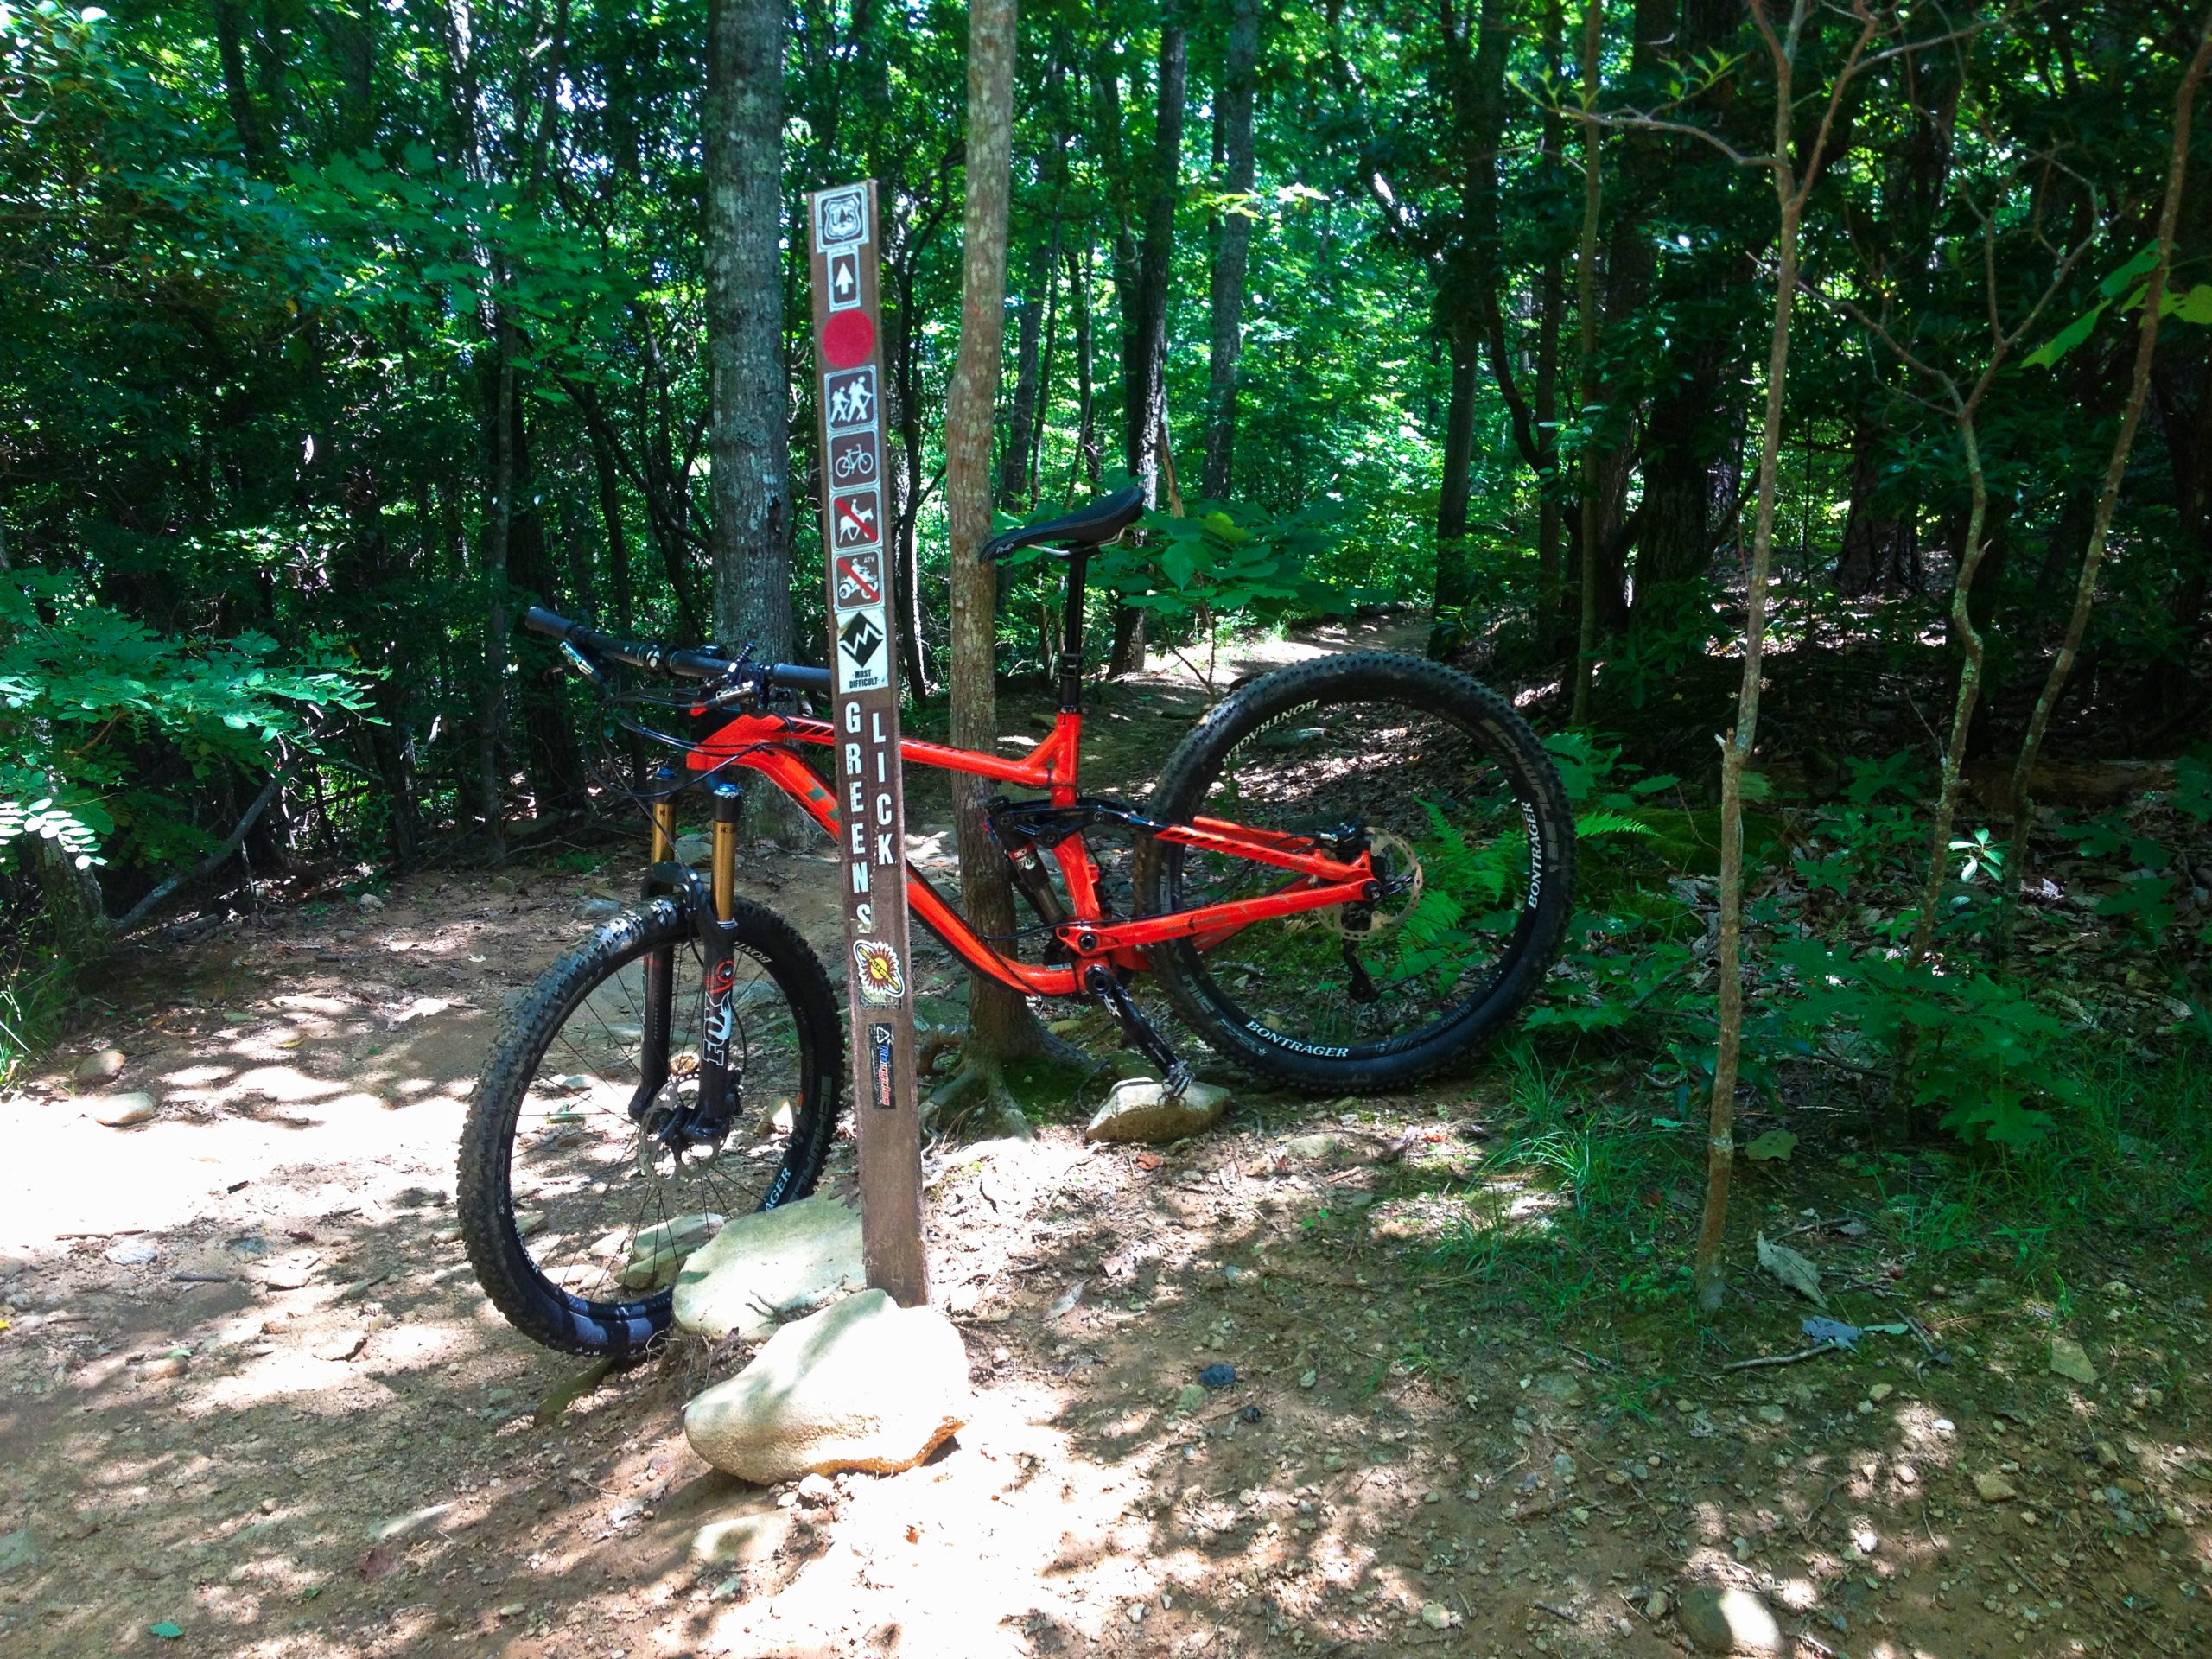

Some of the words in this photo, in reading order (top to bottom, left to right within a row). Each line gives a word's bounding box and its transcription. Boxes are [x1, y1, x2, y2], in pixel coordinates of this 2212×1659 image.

[849, 677, 878, 689] DIFFICULT
[855, 669, 872, 678] MOST
[1222, 698, 1319, 766] BONTRAGER
[872, 712, 894, 866] LICK
[1521, 801, 1542, 910] BONTRAGER
[702, 990, 732, 1066] FOX
[1244, 1020, 1350, 1058] BONTRAGER
